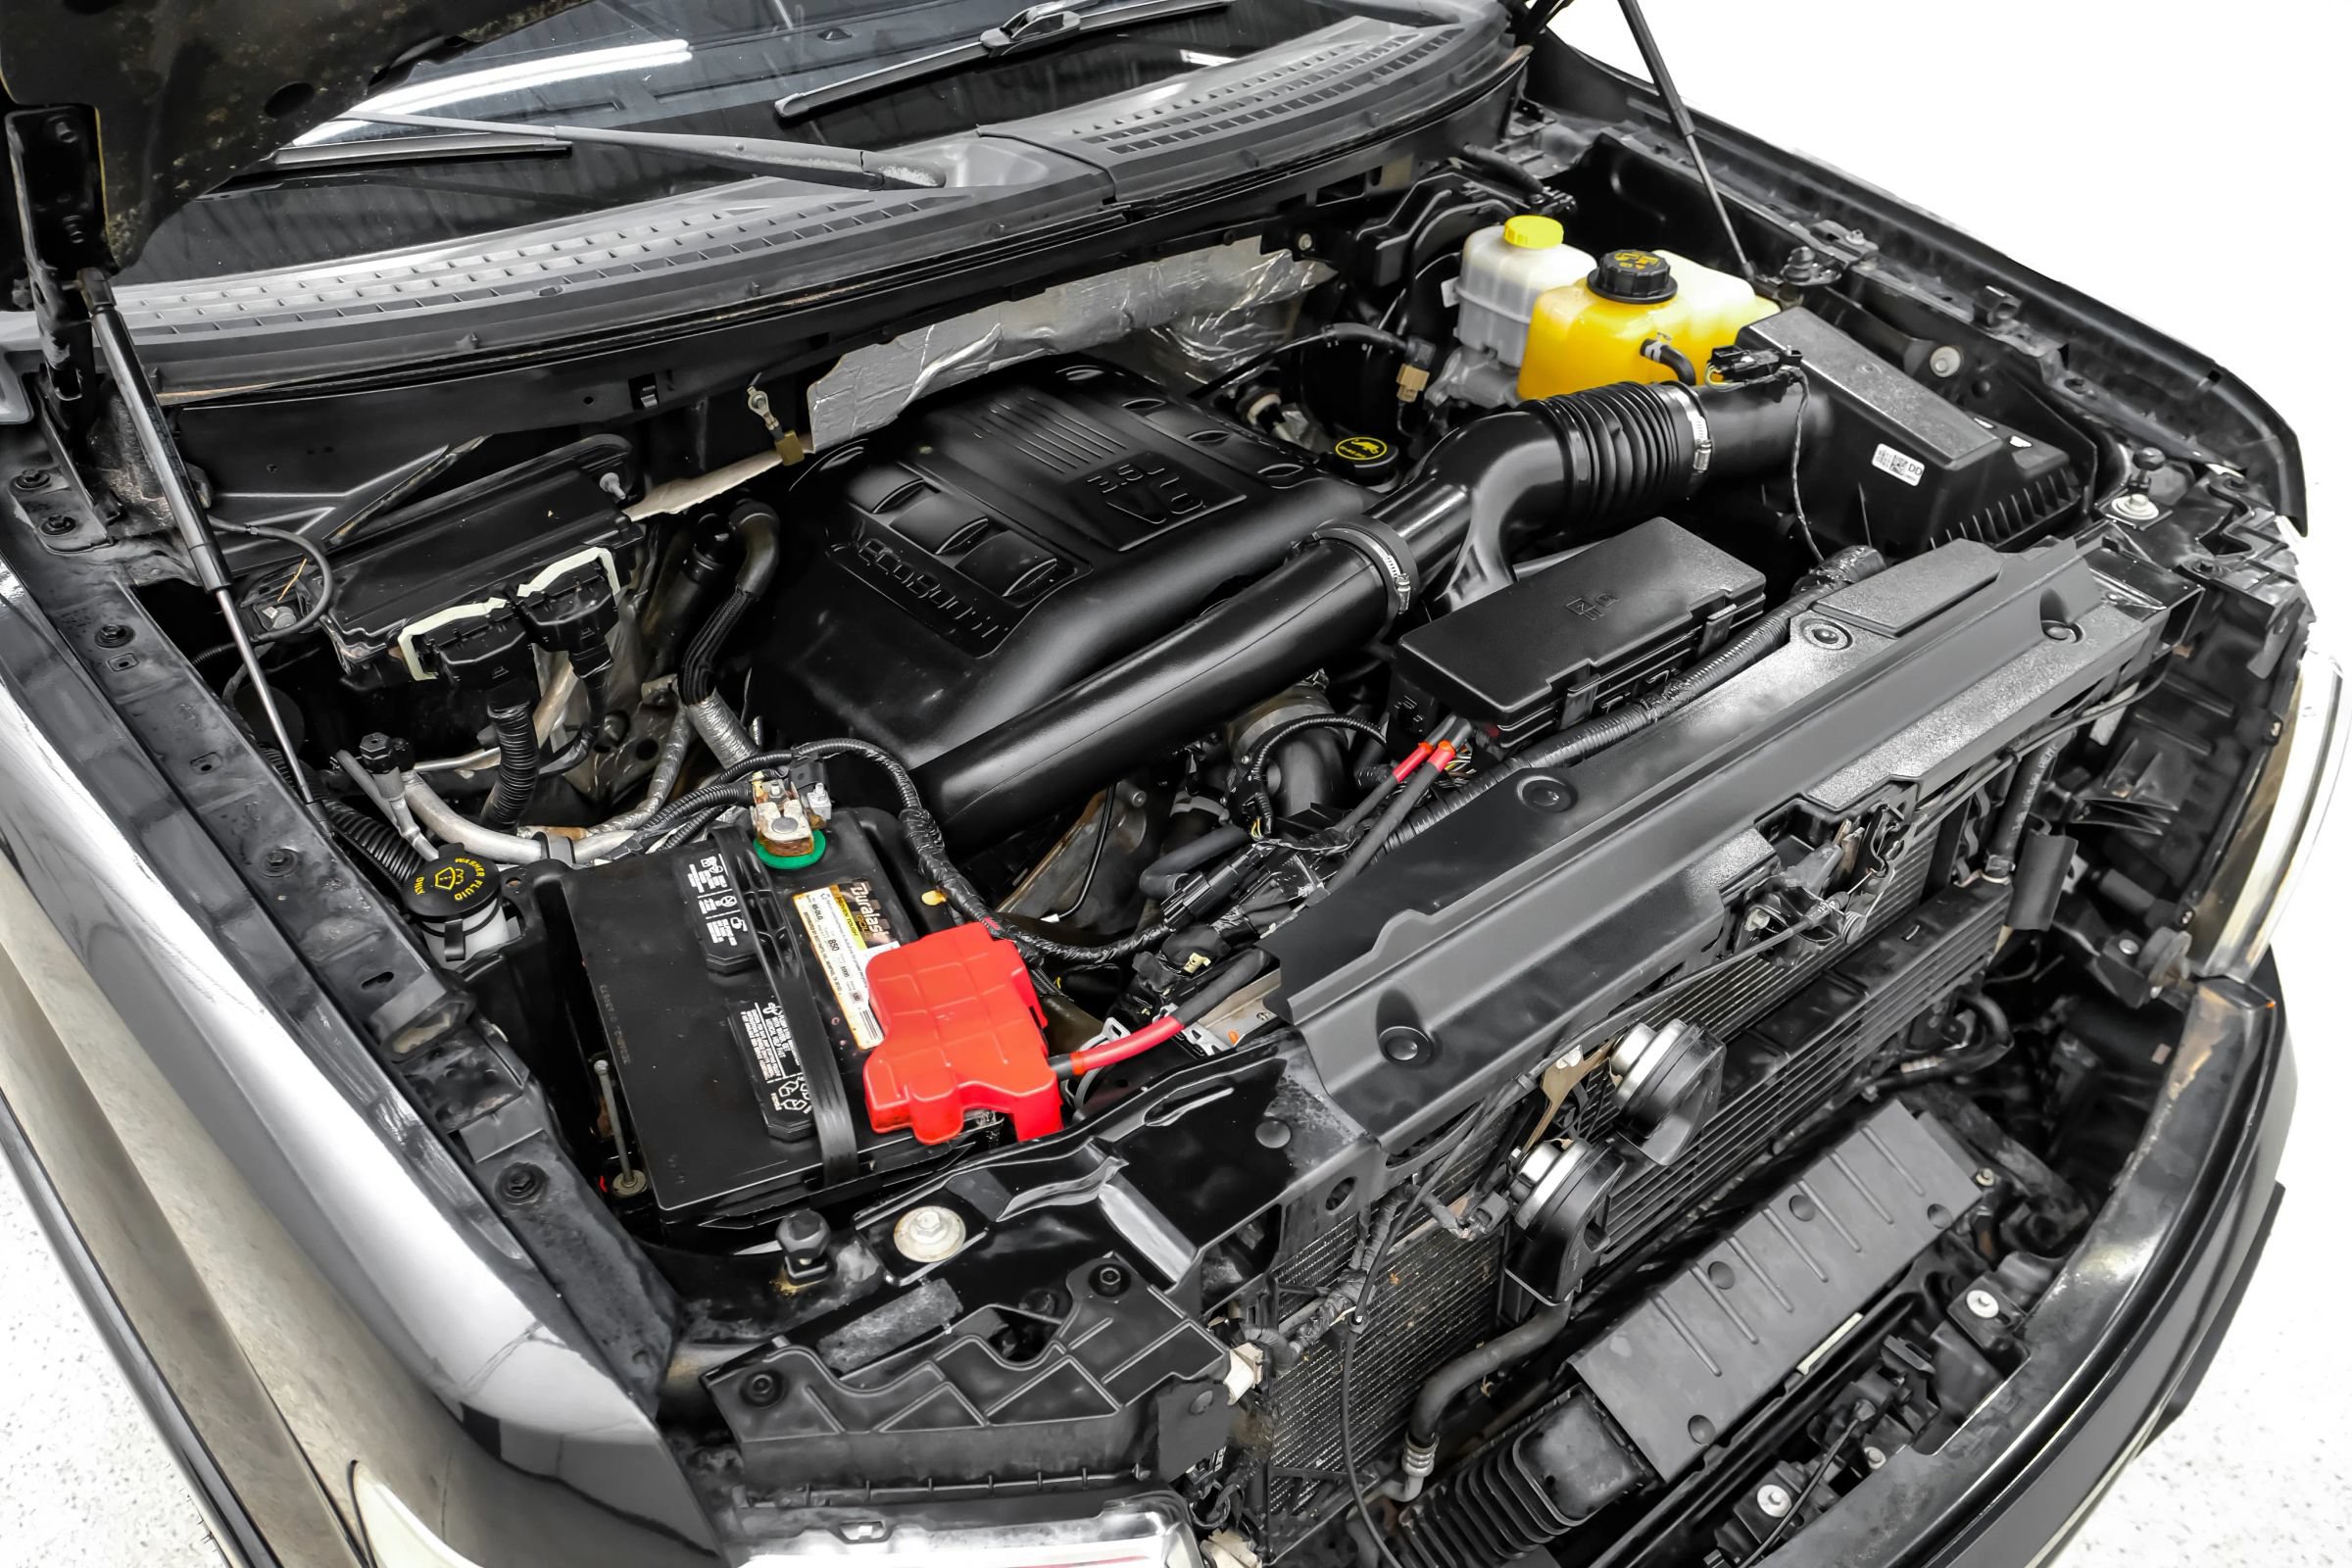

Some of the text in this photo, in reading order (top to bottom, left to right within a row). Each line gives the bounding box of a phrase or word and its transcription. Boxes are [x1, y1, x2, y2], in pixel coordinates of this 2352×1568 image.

[1086, 464, 1166, 494] 3.5L
[1908, 463, 1923, 476] DD
[1104, 476, 1204, 525] V6
[415, 858, 486, 902] WASHER FLUID ONLY
[849, 882, 890, 942] Duralast
[846, 918, 859, 936] TOUGH
[856, 914, 873, 940] GOLD
[828, 939, 840, 952] 850
